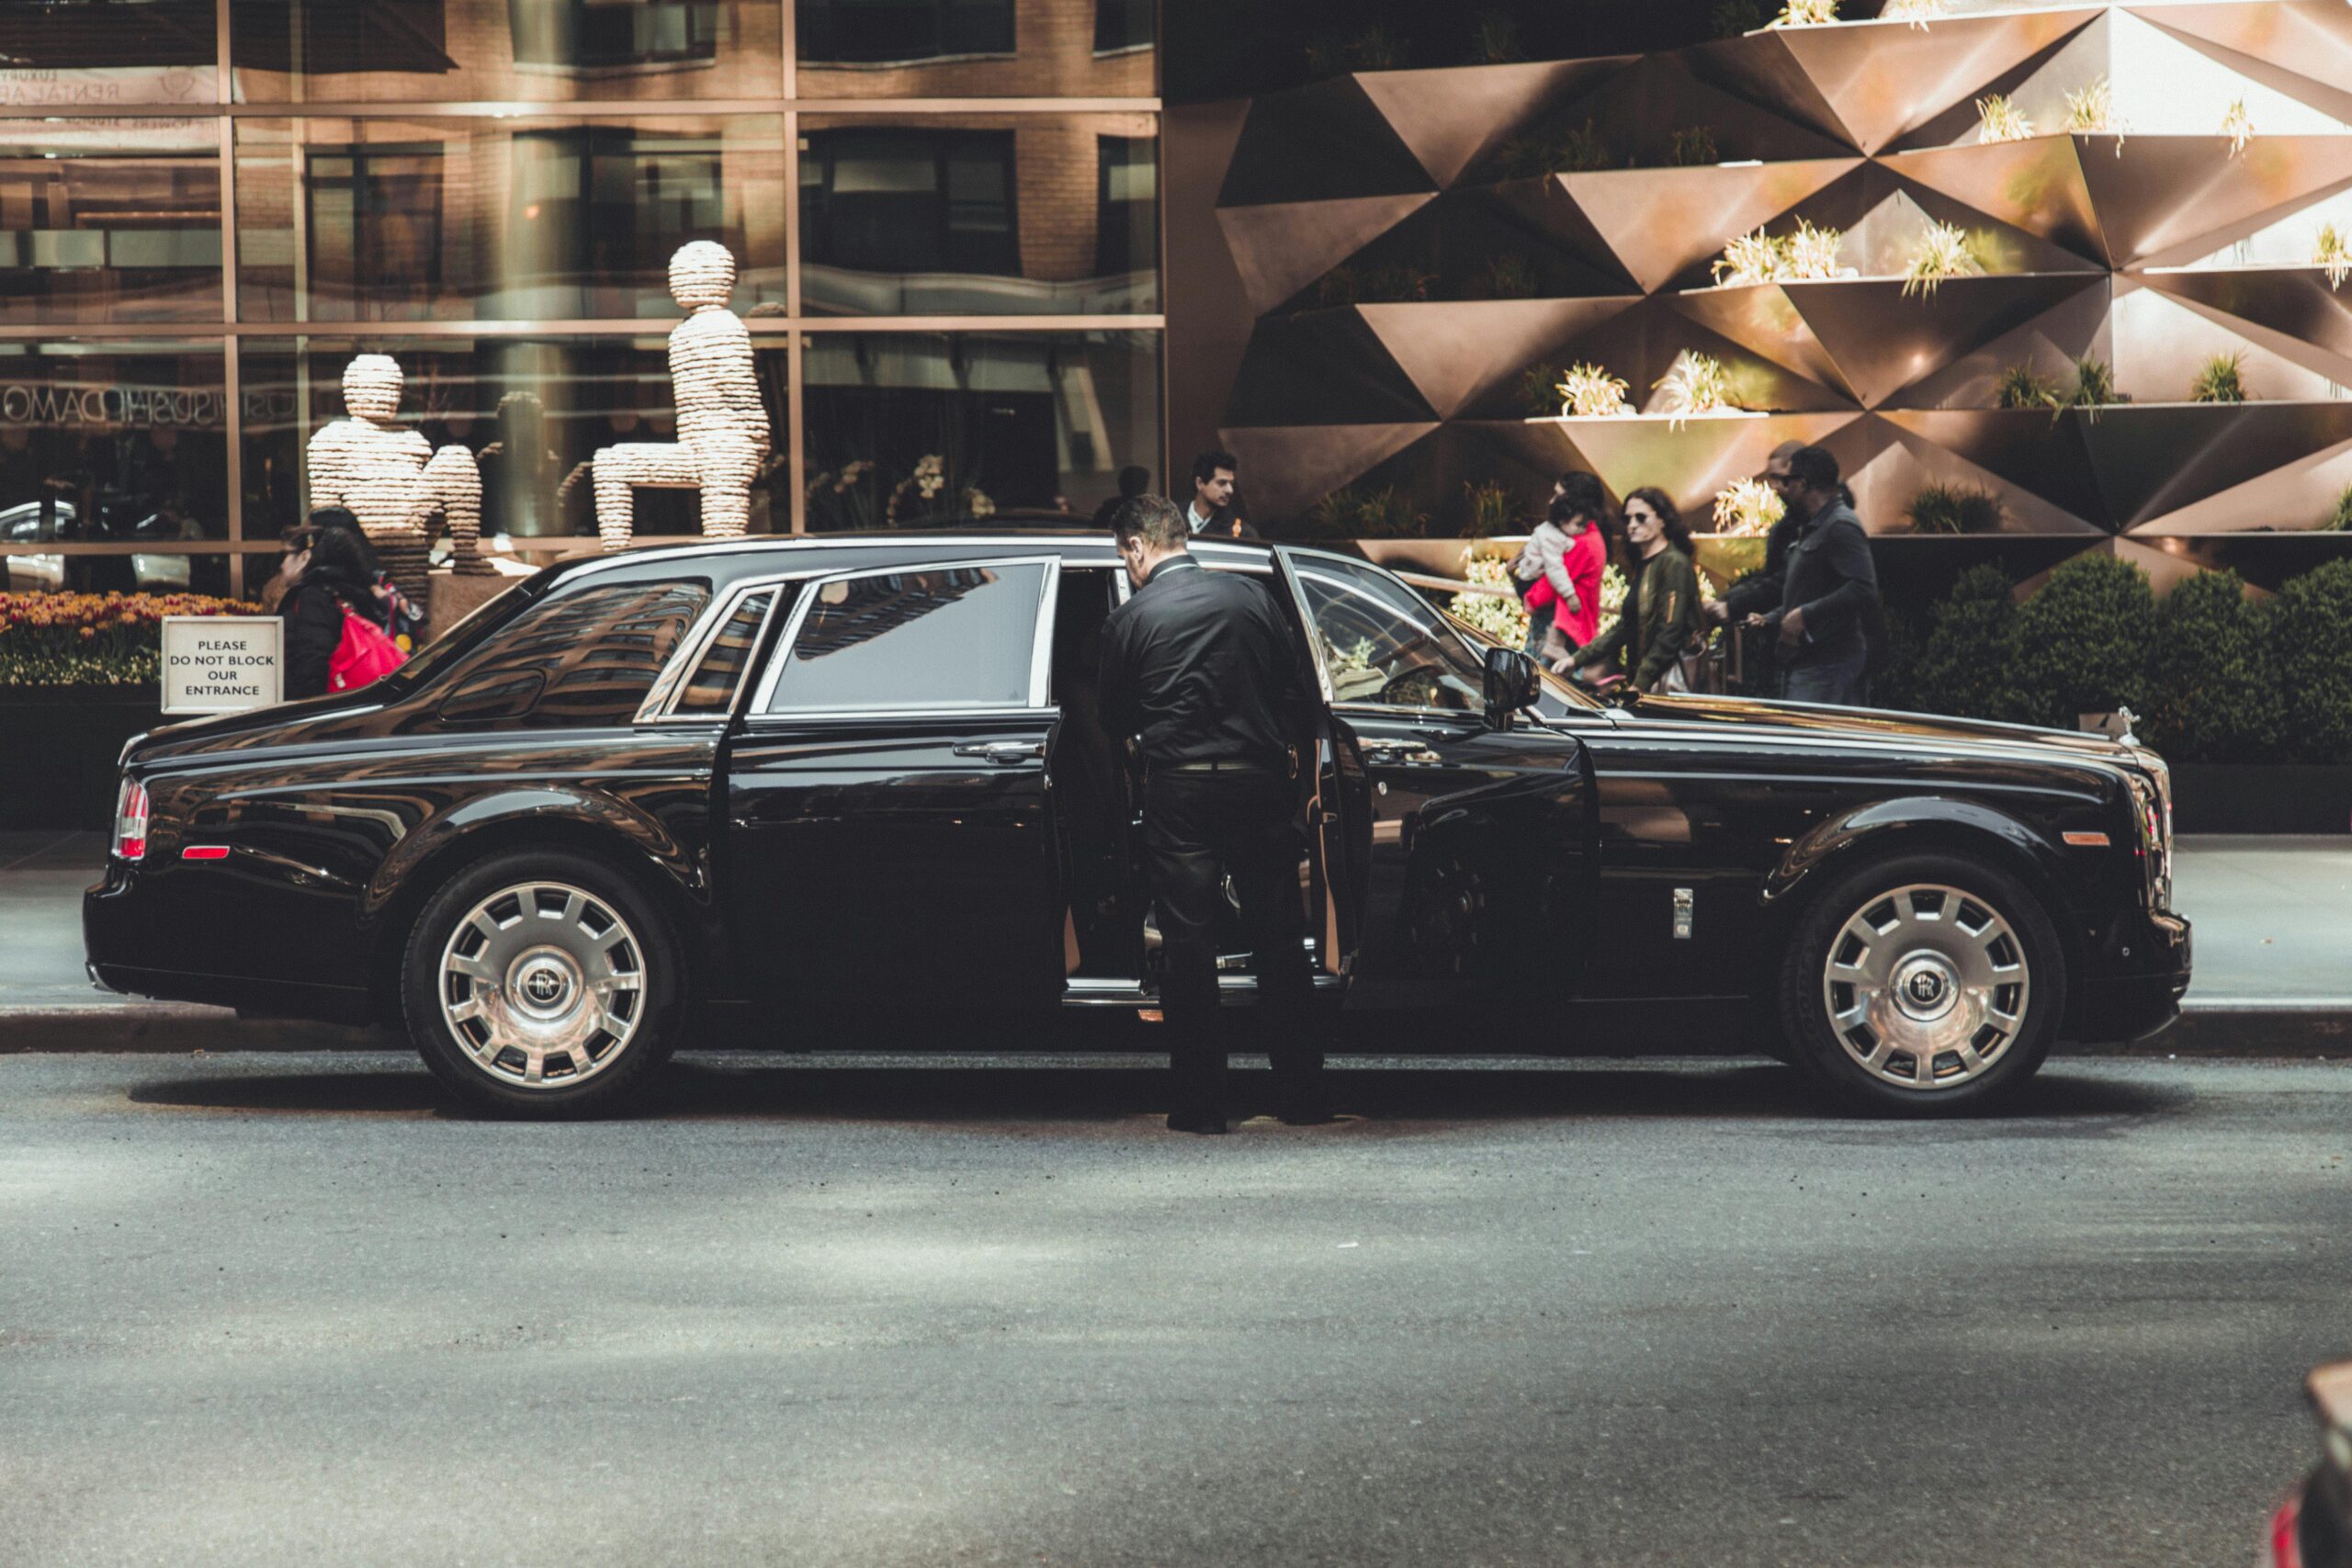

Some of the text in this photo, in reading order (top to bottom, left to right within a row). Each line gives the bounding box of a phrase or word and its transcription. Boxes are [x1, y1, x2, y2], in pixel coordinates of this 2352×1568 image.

[198, 641, 247, 650] PLEASE
[170, 656, 274, 665] DO NOT BLOCK
[208, 671, 237, 680] OUR
[186, 685, 259, 695] ENTRANCE
